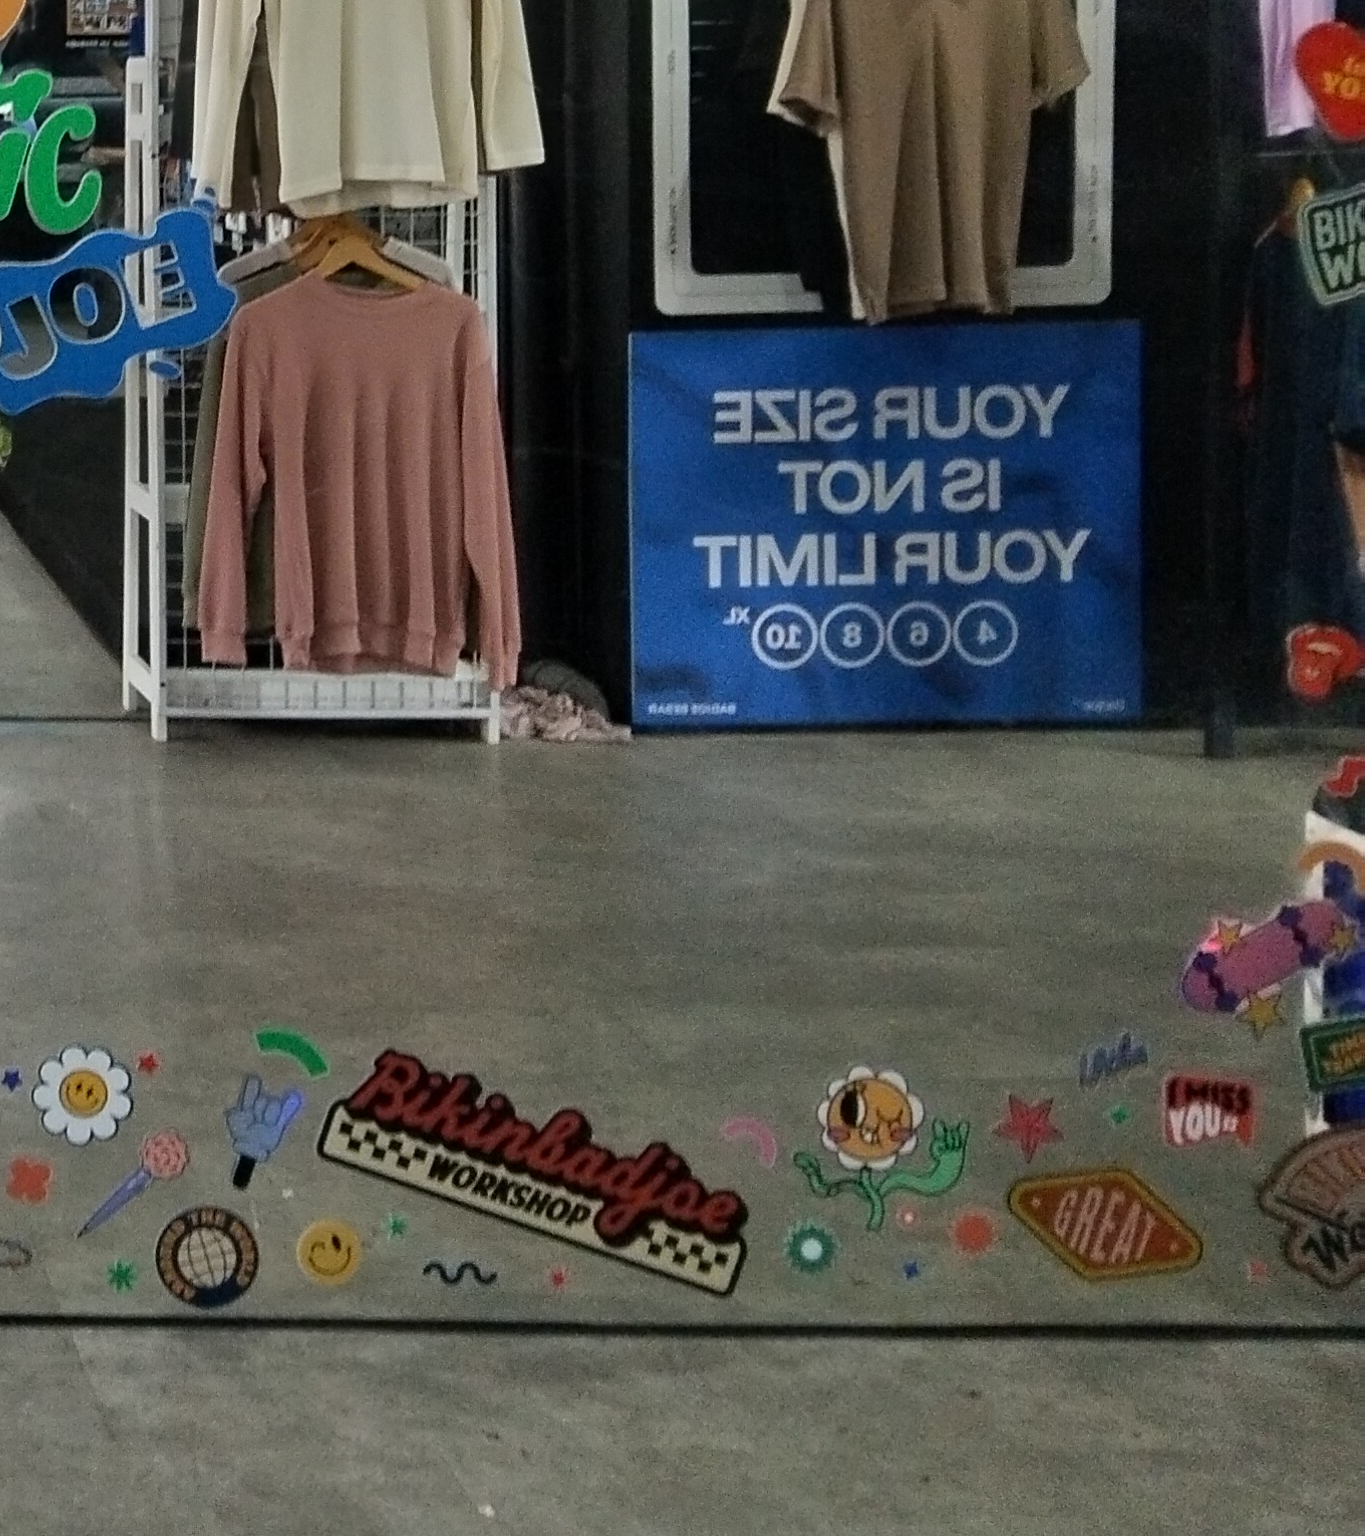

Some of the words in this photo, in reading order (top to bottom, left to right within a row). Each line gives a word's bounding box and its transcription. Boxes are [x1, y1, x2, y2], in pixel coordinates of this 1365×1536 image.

[346, 1050, 745, 1245] Bikinbadjoe
[427, 1151, 594, 1227] WORKSHOP
[1053, 1185, 1158, 1265] GREAT
